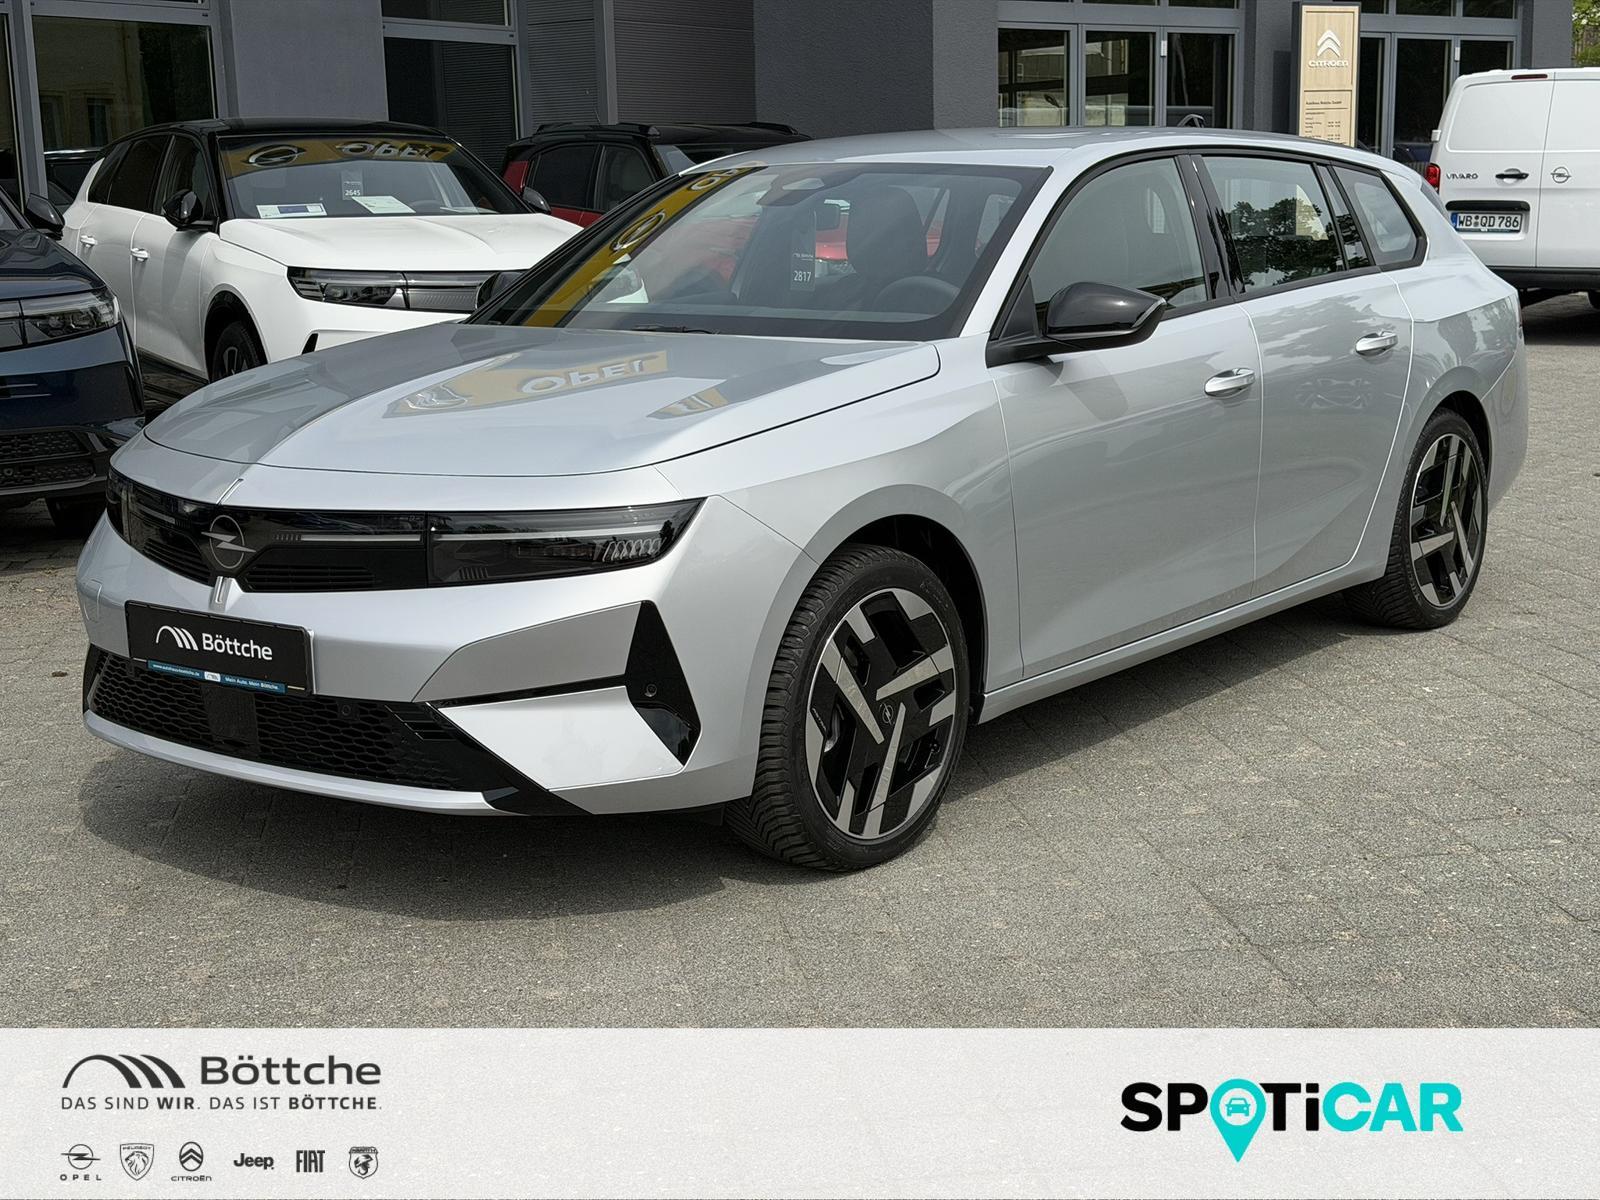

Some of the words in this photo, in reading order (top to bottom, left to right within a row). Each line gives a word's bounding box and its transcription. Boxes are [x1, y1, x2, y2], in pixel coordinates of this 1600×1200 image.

[1458, 215, 1473, 227] WB
[1480, 215, 1496, 228] QD
[1498, 216, 1519, 228] 786
[793, 270, 812, 282] 2817
[201, 632, 273, 661] Böttche
